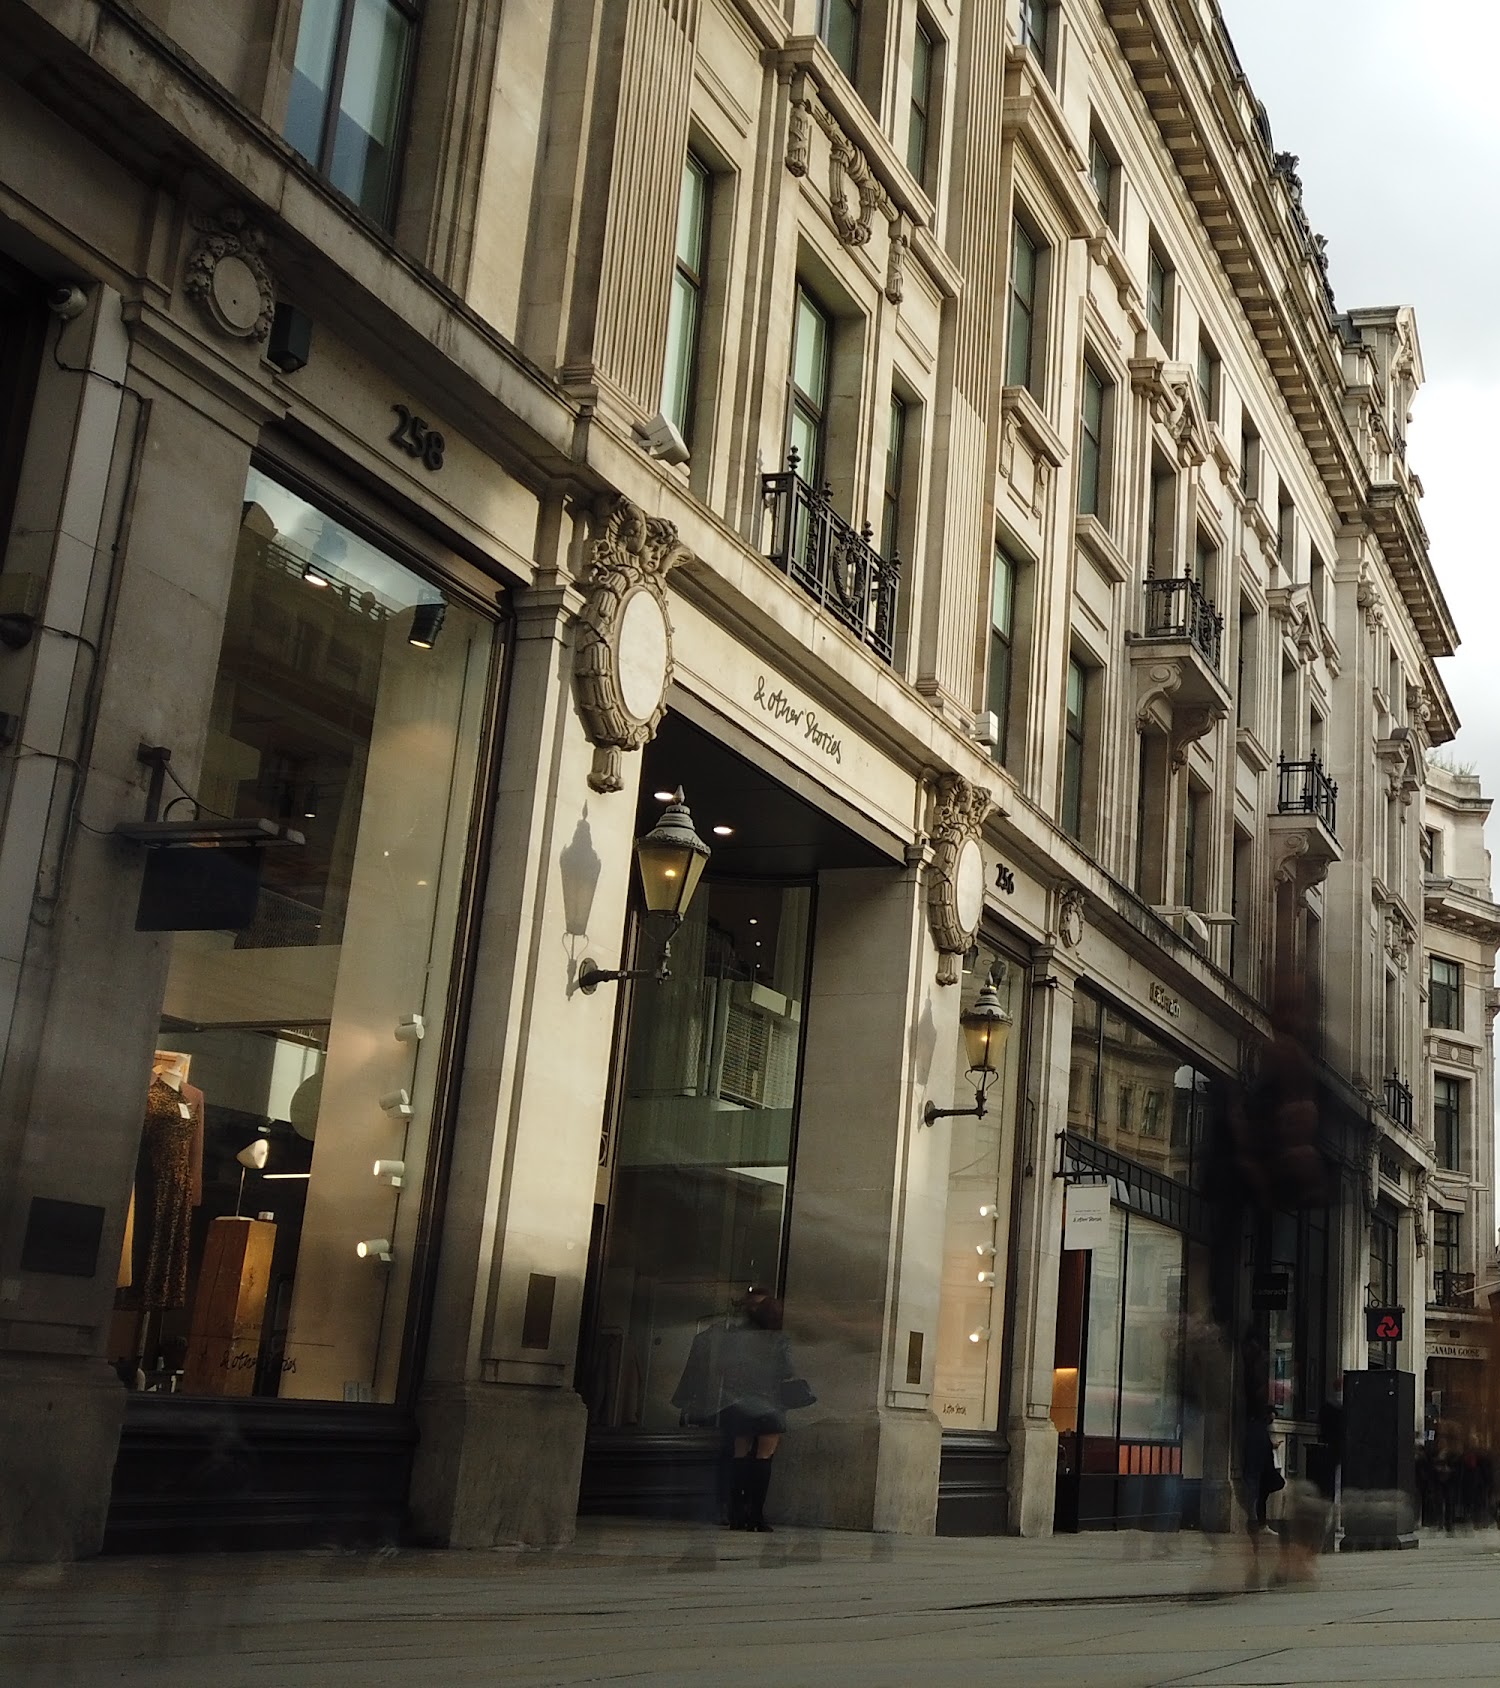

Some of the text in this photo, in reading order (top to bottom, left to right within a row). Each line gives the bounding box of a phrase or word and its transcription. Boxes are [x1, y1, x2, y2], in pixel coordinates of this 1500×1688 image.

[389, 404, 445, 471] 258
[754, 675, 766, 710] &
[804, 711, 841, 764] Stories
[995, 863, 1014, 895] 256
